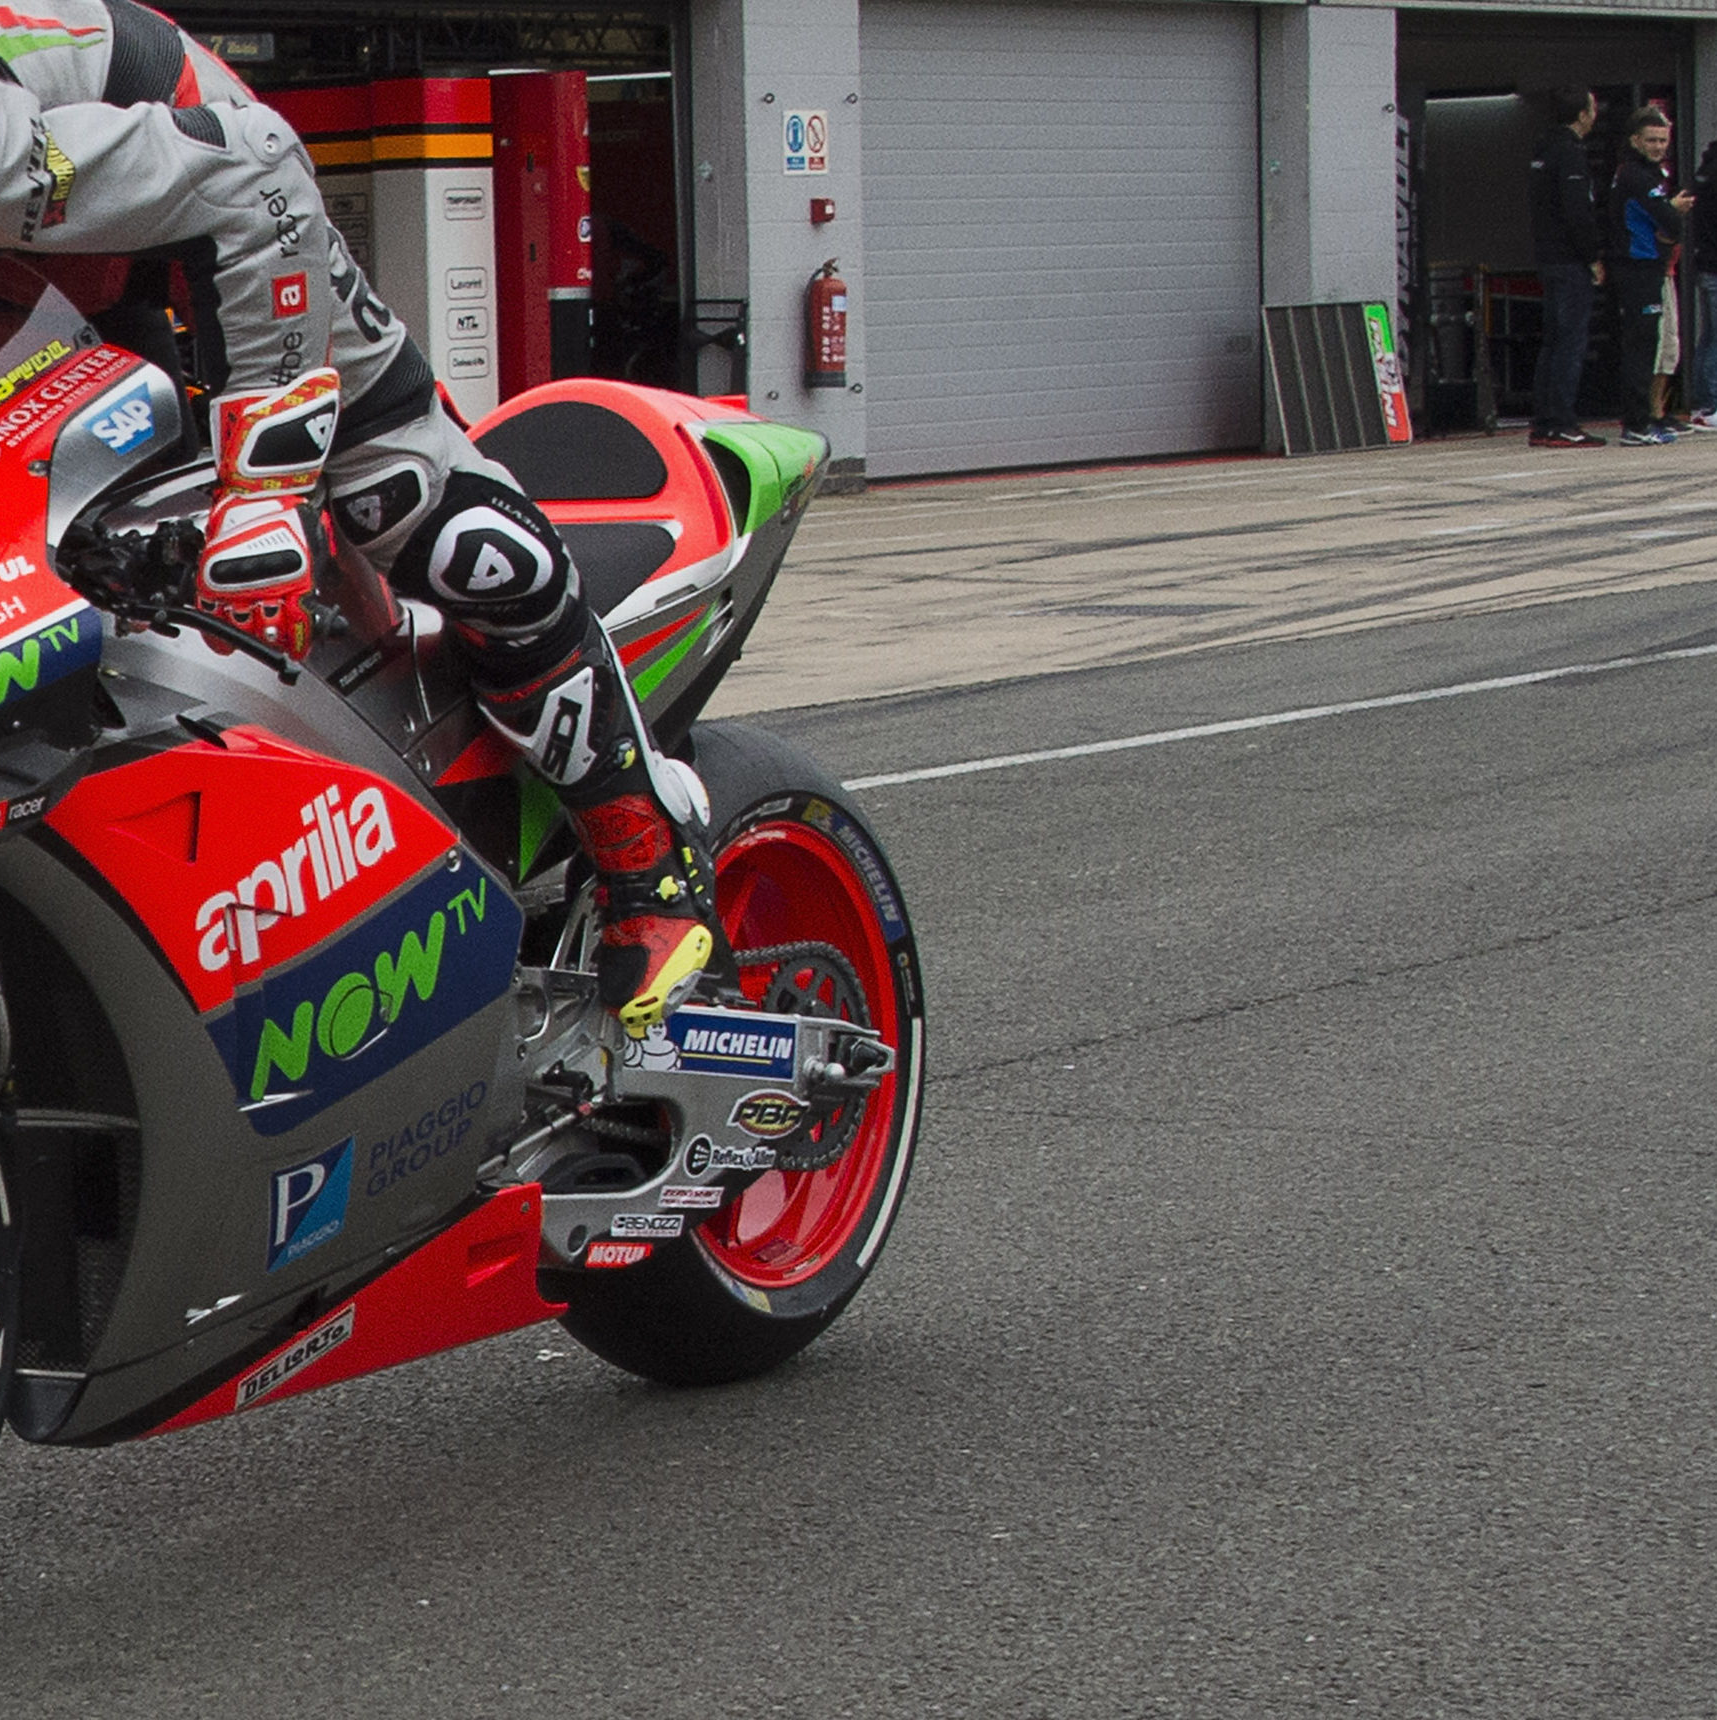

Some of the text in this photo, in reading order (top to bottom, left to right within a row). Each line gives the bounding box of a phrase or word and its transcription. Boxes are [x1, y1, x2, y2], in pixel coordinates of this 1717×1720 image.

[259, 187, 301, 258] racer
[39, 348, 120, 401] CENTER
[91, 400, 152, 449] SAP
[39, 617, 80, 652] TV
[7, 796, 46, 821] racer
[194, 784, 398, 973] aprilia
[836, 824, 900, 922] MICHELIN
[250, 877, 486, 1101] NOW TV
[683, 1028, 794, 1060] MICHELIN
[366, 1118, 472, 1198] GROUP
[369, 1081, 487, 1169] PIAGGIO
[275, 1162, 326, 1246] P
[287, 1218, 340, 1258] PIAGGIO
